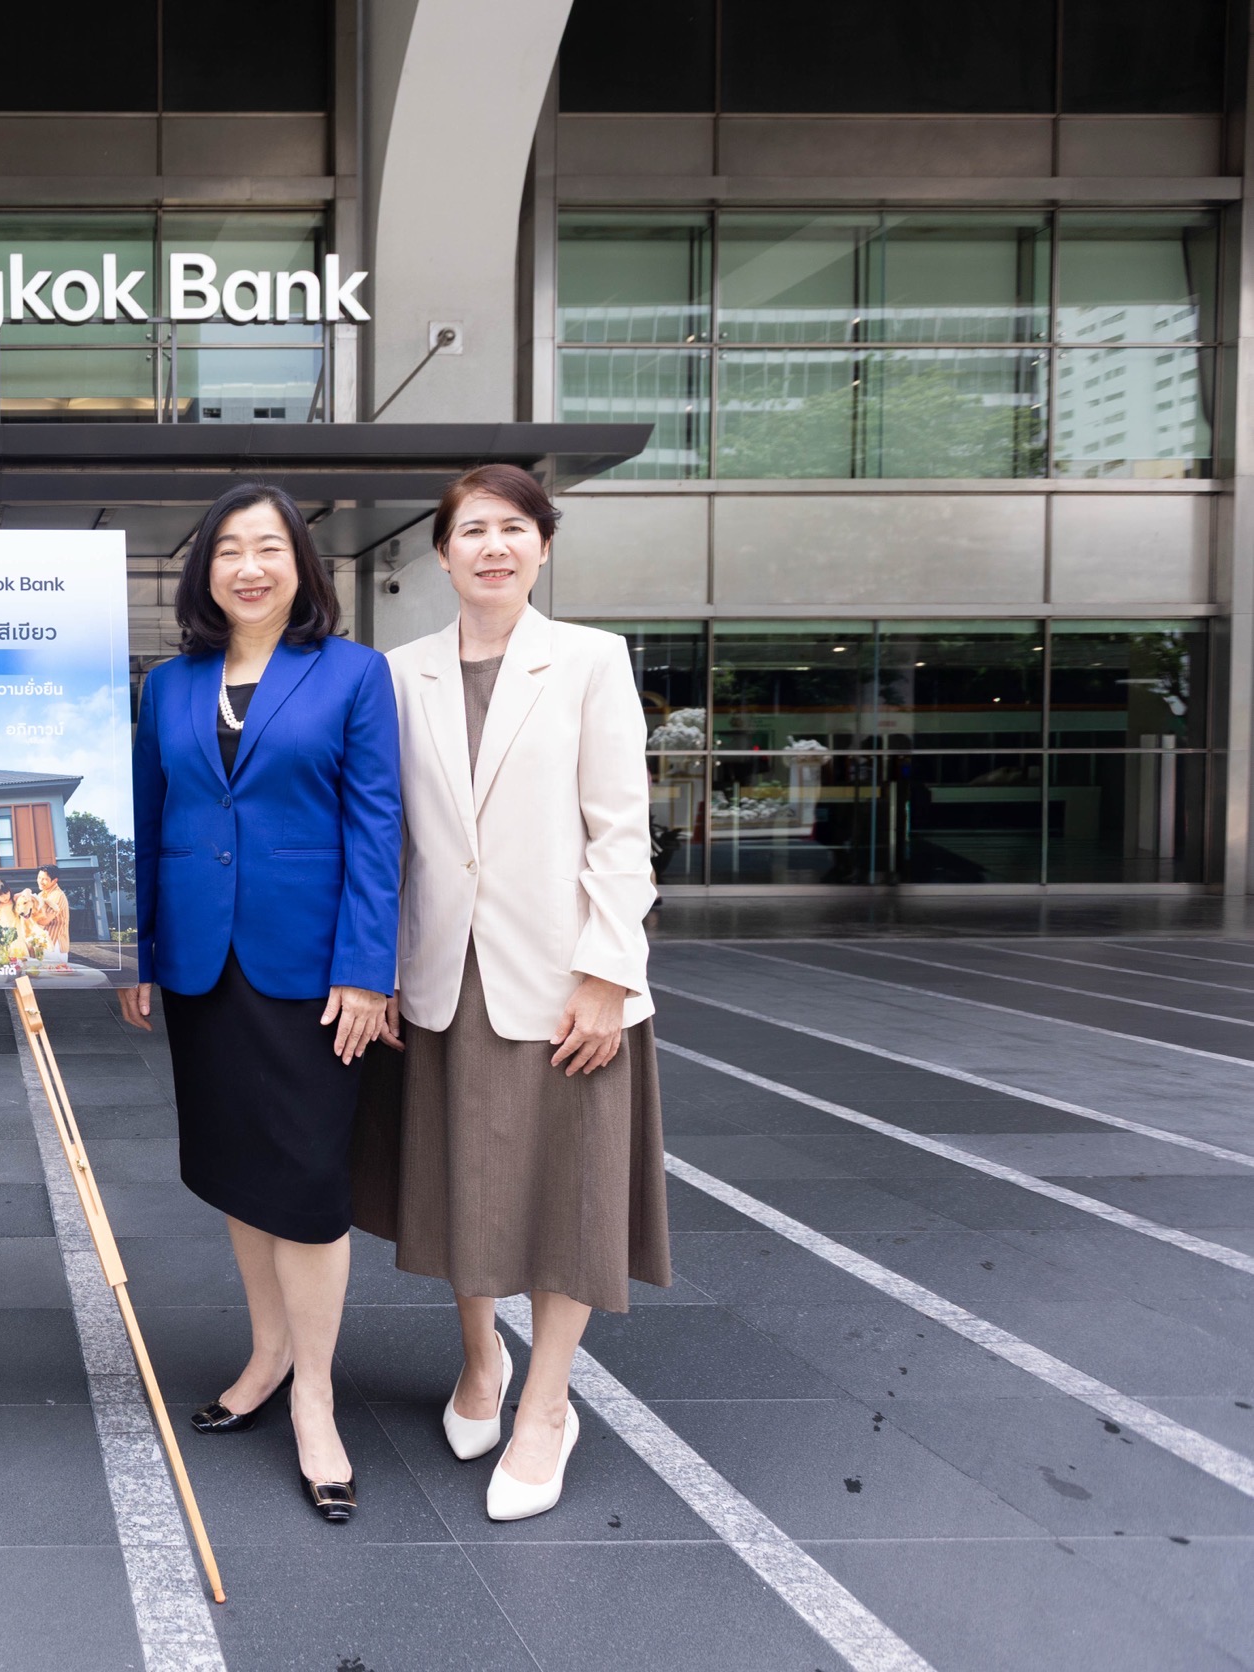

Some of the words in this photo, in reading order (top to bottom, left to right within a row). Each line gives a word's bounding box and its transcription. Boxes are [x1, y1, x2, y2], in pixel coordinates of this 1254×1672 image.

[169, 251, 371, 323] Bank
[19, 576, 66, 592] Bank
[5, 721, 65, 737] อภิทาวน์
